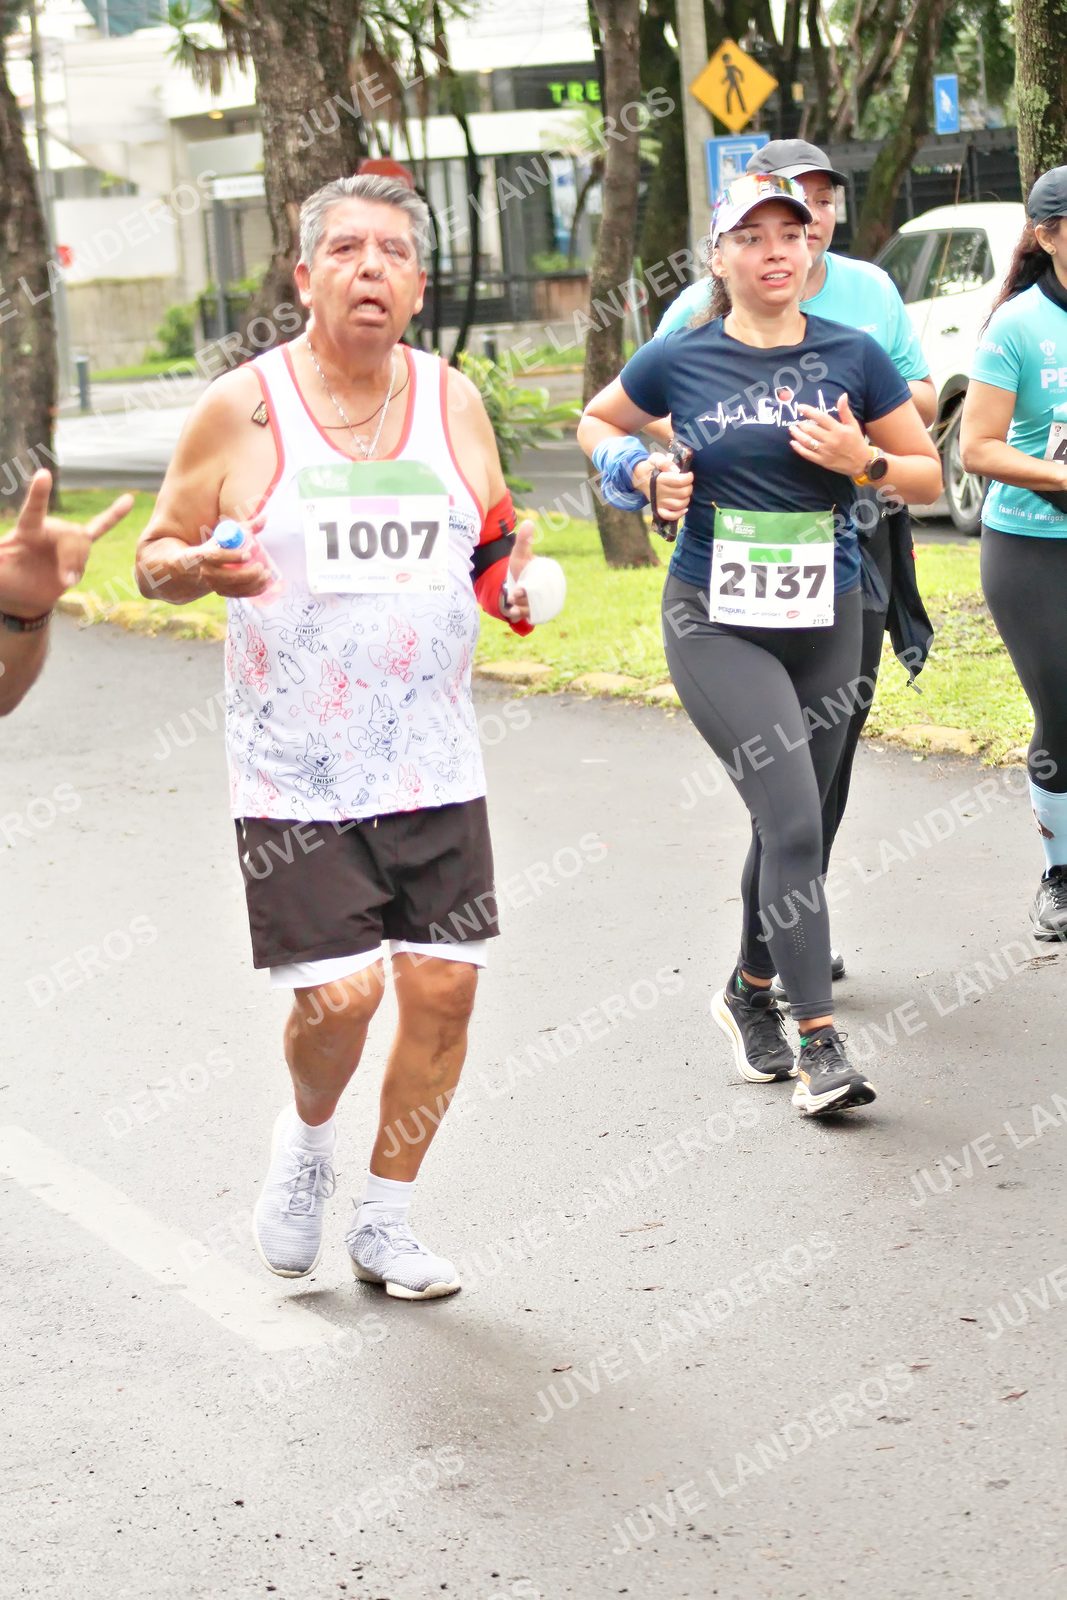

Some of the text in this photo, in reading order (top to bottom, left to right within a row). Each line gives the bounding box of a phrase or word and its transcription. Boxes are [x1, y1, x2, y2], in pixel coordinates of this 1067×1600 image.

[547, 80, 601, 104] TRE
[998, 503, 1026, 517] familia
[1034, 512, 1065, 523] amigos
[318, 521, 440, 560] 1007
[719, 562, 826, 600] 2137
[294, 626, 324, 635] FINISH!
[309, 776, 338, 784] FINISH!
